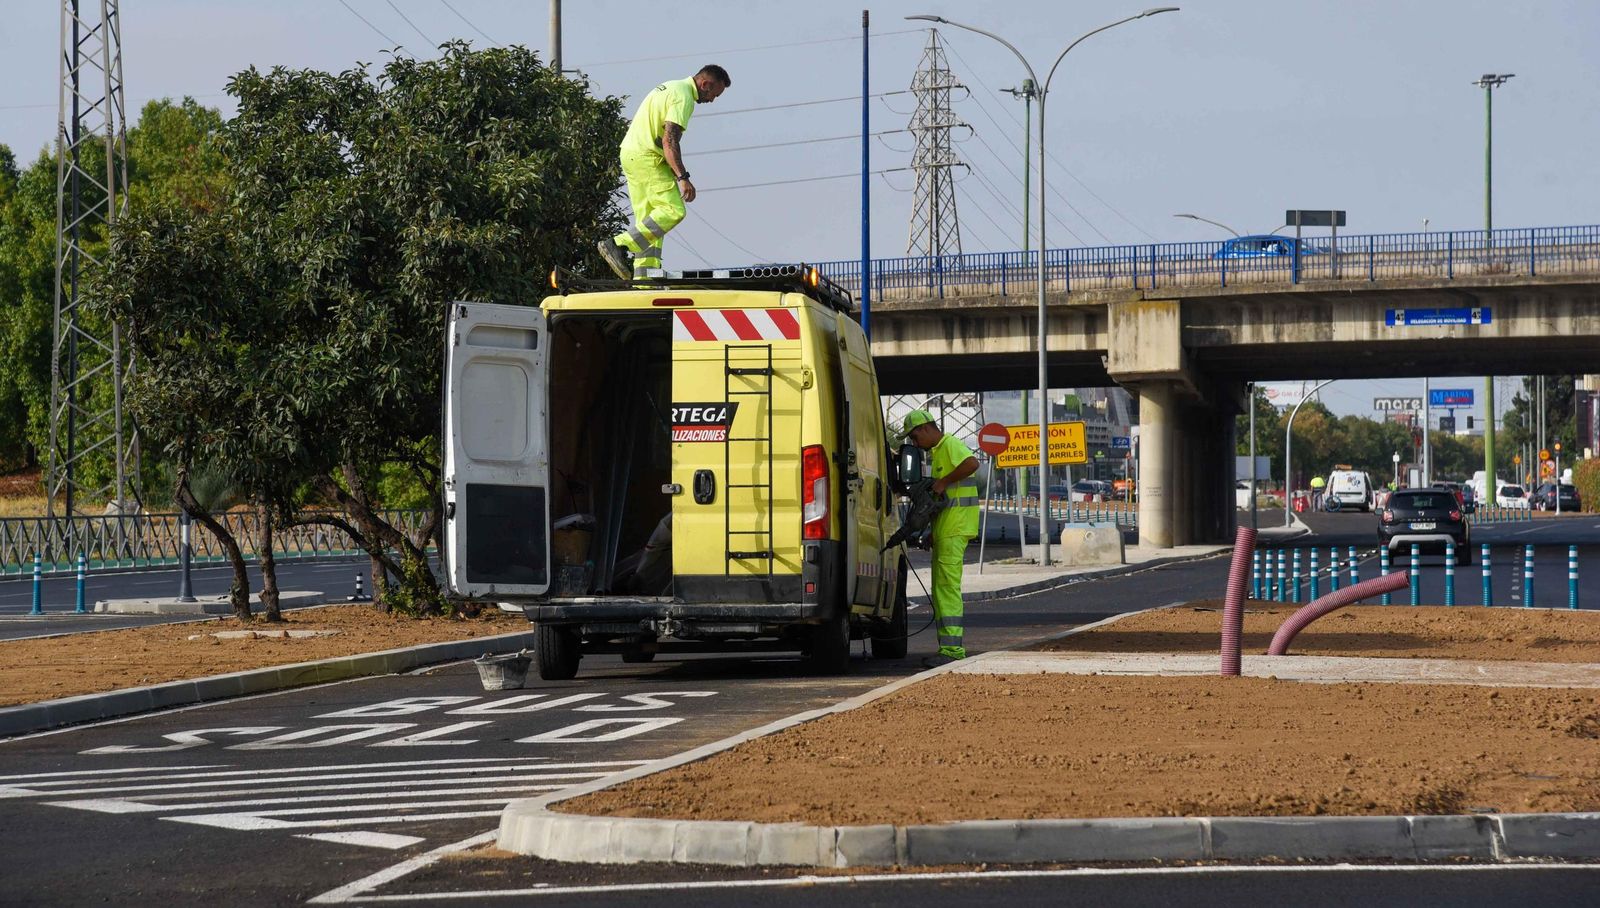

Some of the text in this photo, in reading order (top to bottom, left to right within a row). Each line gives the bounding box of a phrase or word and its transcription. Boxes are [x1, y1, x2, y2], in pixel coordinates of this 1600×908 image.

[1013, 428, 1066, 440] ATENIÓN
[999, 453, 1029, 462] CIERRE
[1049, 450, 1084, 460] ARRILES
[309, 690, 720, 719] BUS
[77, 716, 686, 755] SOLO
